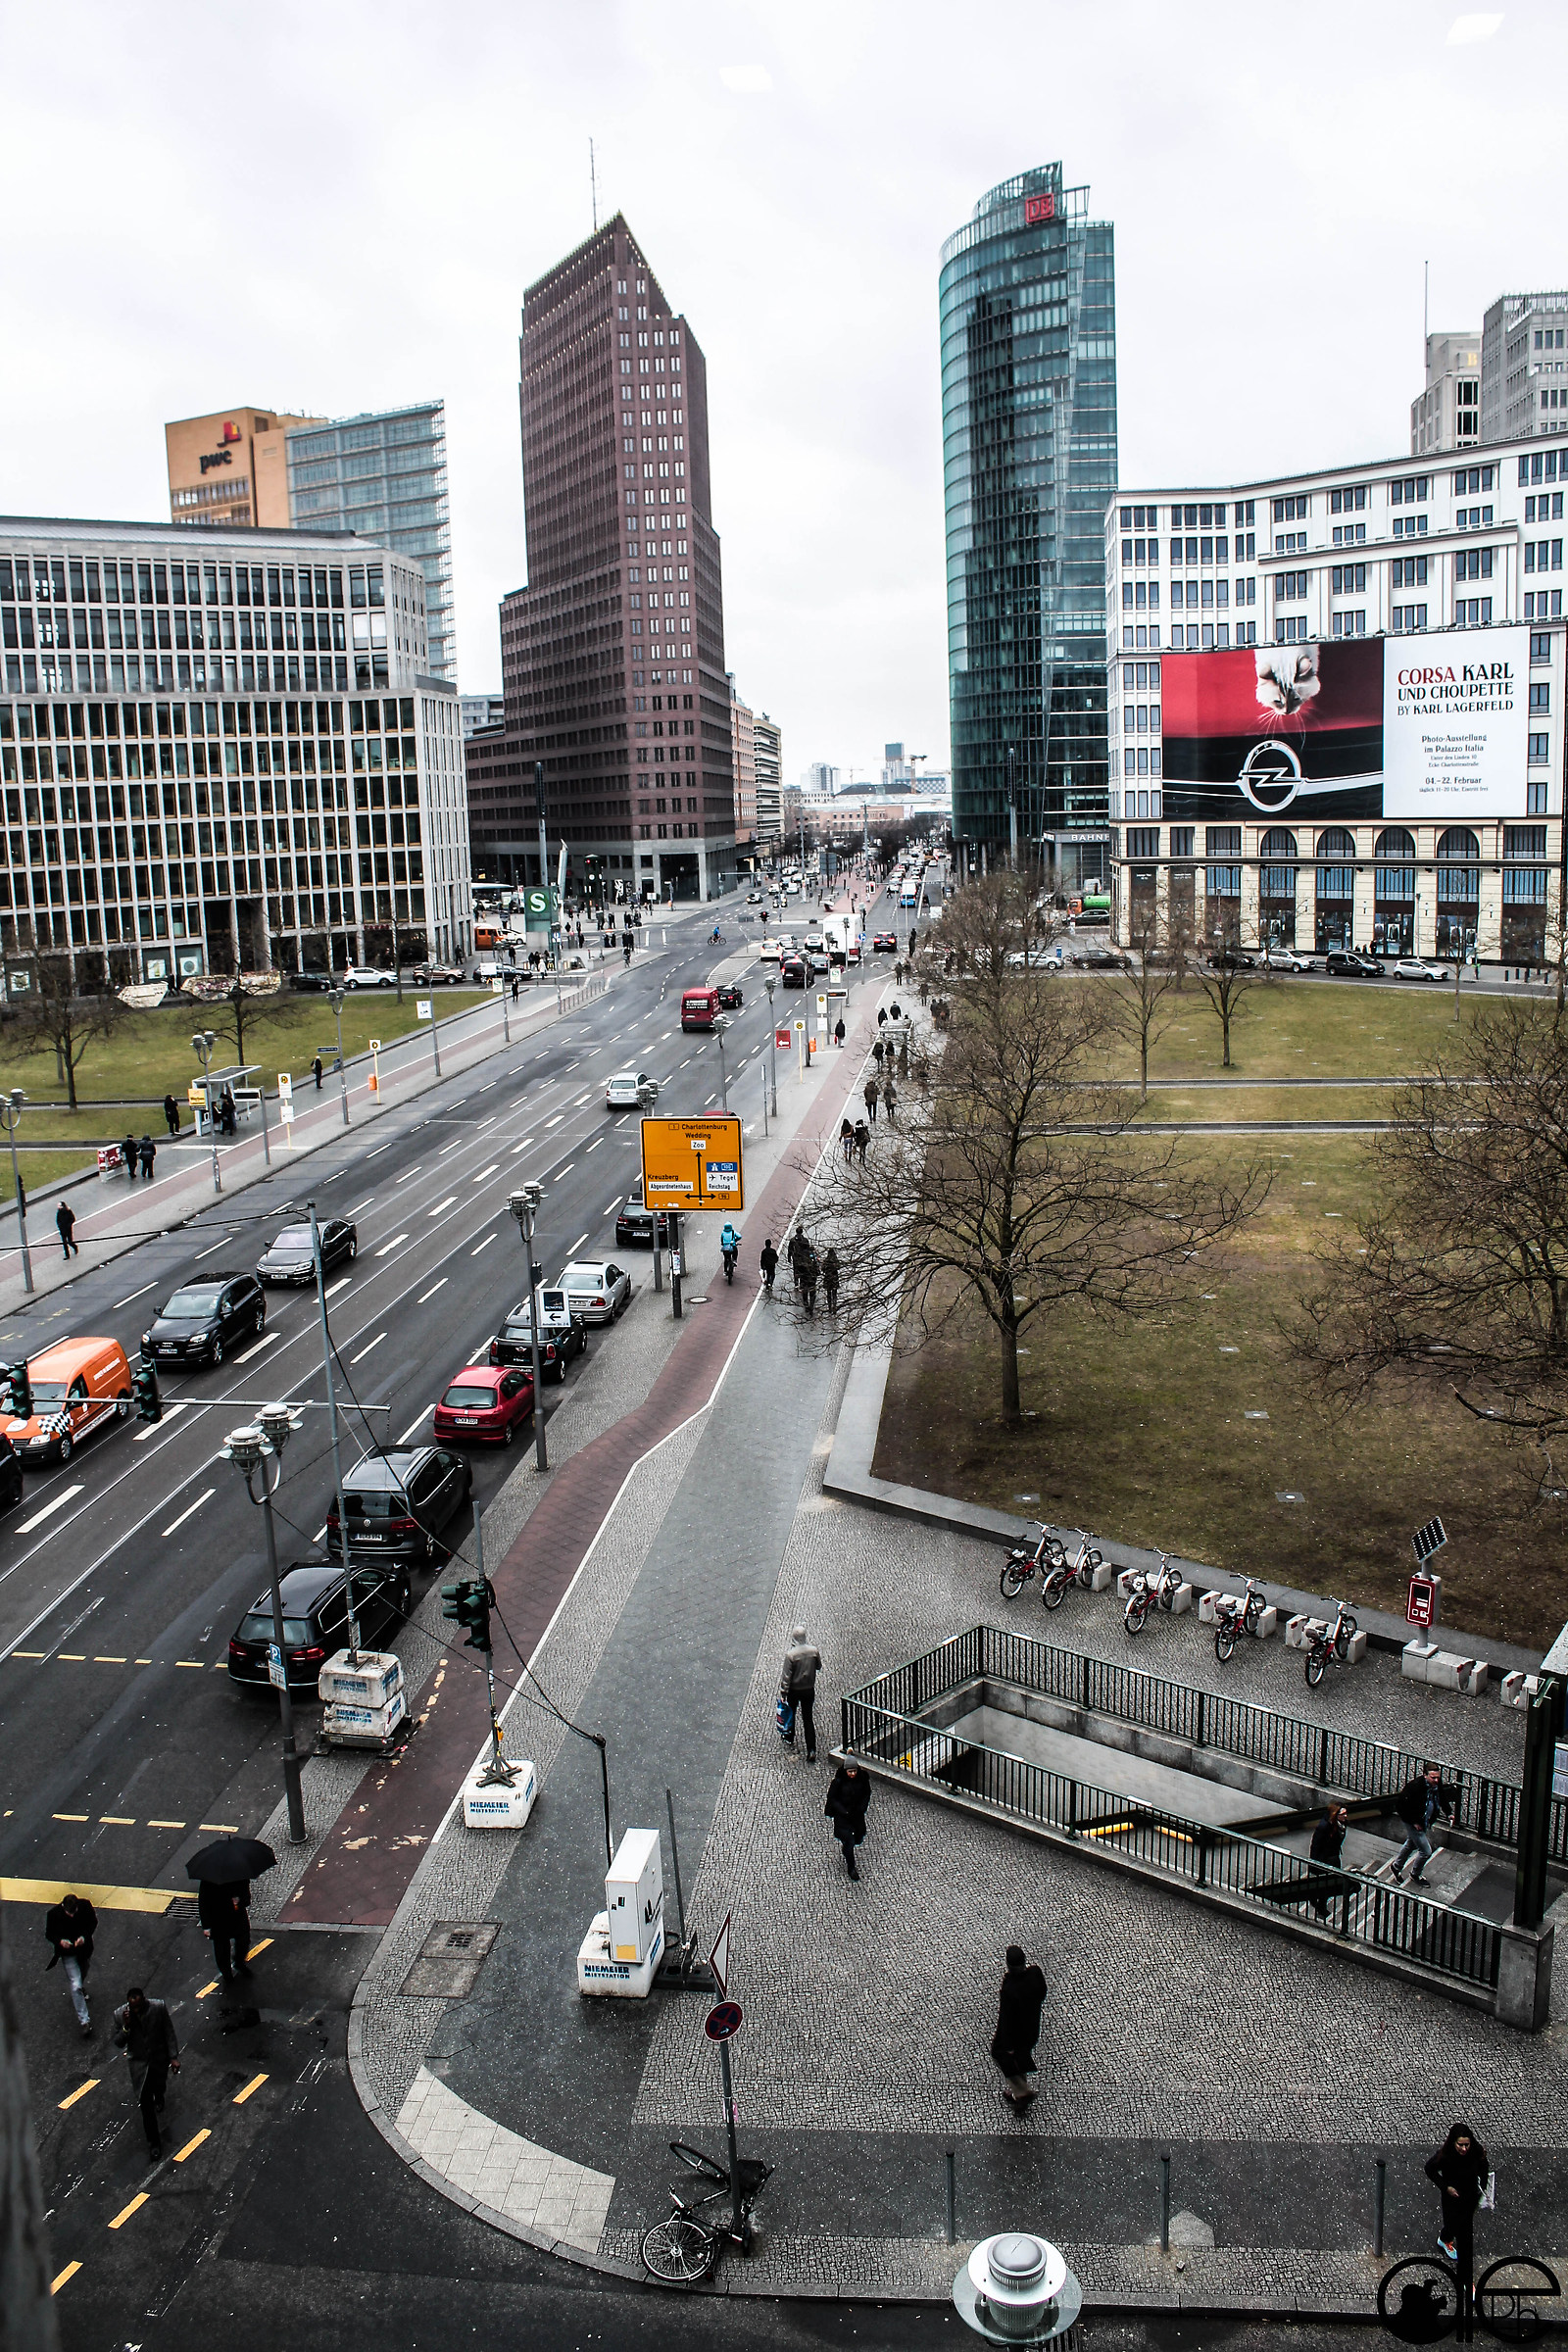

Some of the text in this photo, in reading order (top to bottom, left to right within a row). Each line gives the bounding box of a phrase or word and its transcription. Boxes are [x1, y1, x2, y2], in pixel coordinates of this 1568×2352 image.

[1029, 198, 1051, 218] DB
[199, 450, 232, 474] pwc
[1397, 662, 1514, 685] CORSA KARL
[1397, 682, 1514, 701] UND CHOUPETTE
[1397, 700, 1514, 715] BY KARL LAGERFELD
[1421, 734, 1488, 743] Photo-Ausstellung
[530, 893, 546, 911] S
[271, 1646, 278, 1660] P
[584, 1964, 630, 1974] NIEMEIER
